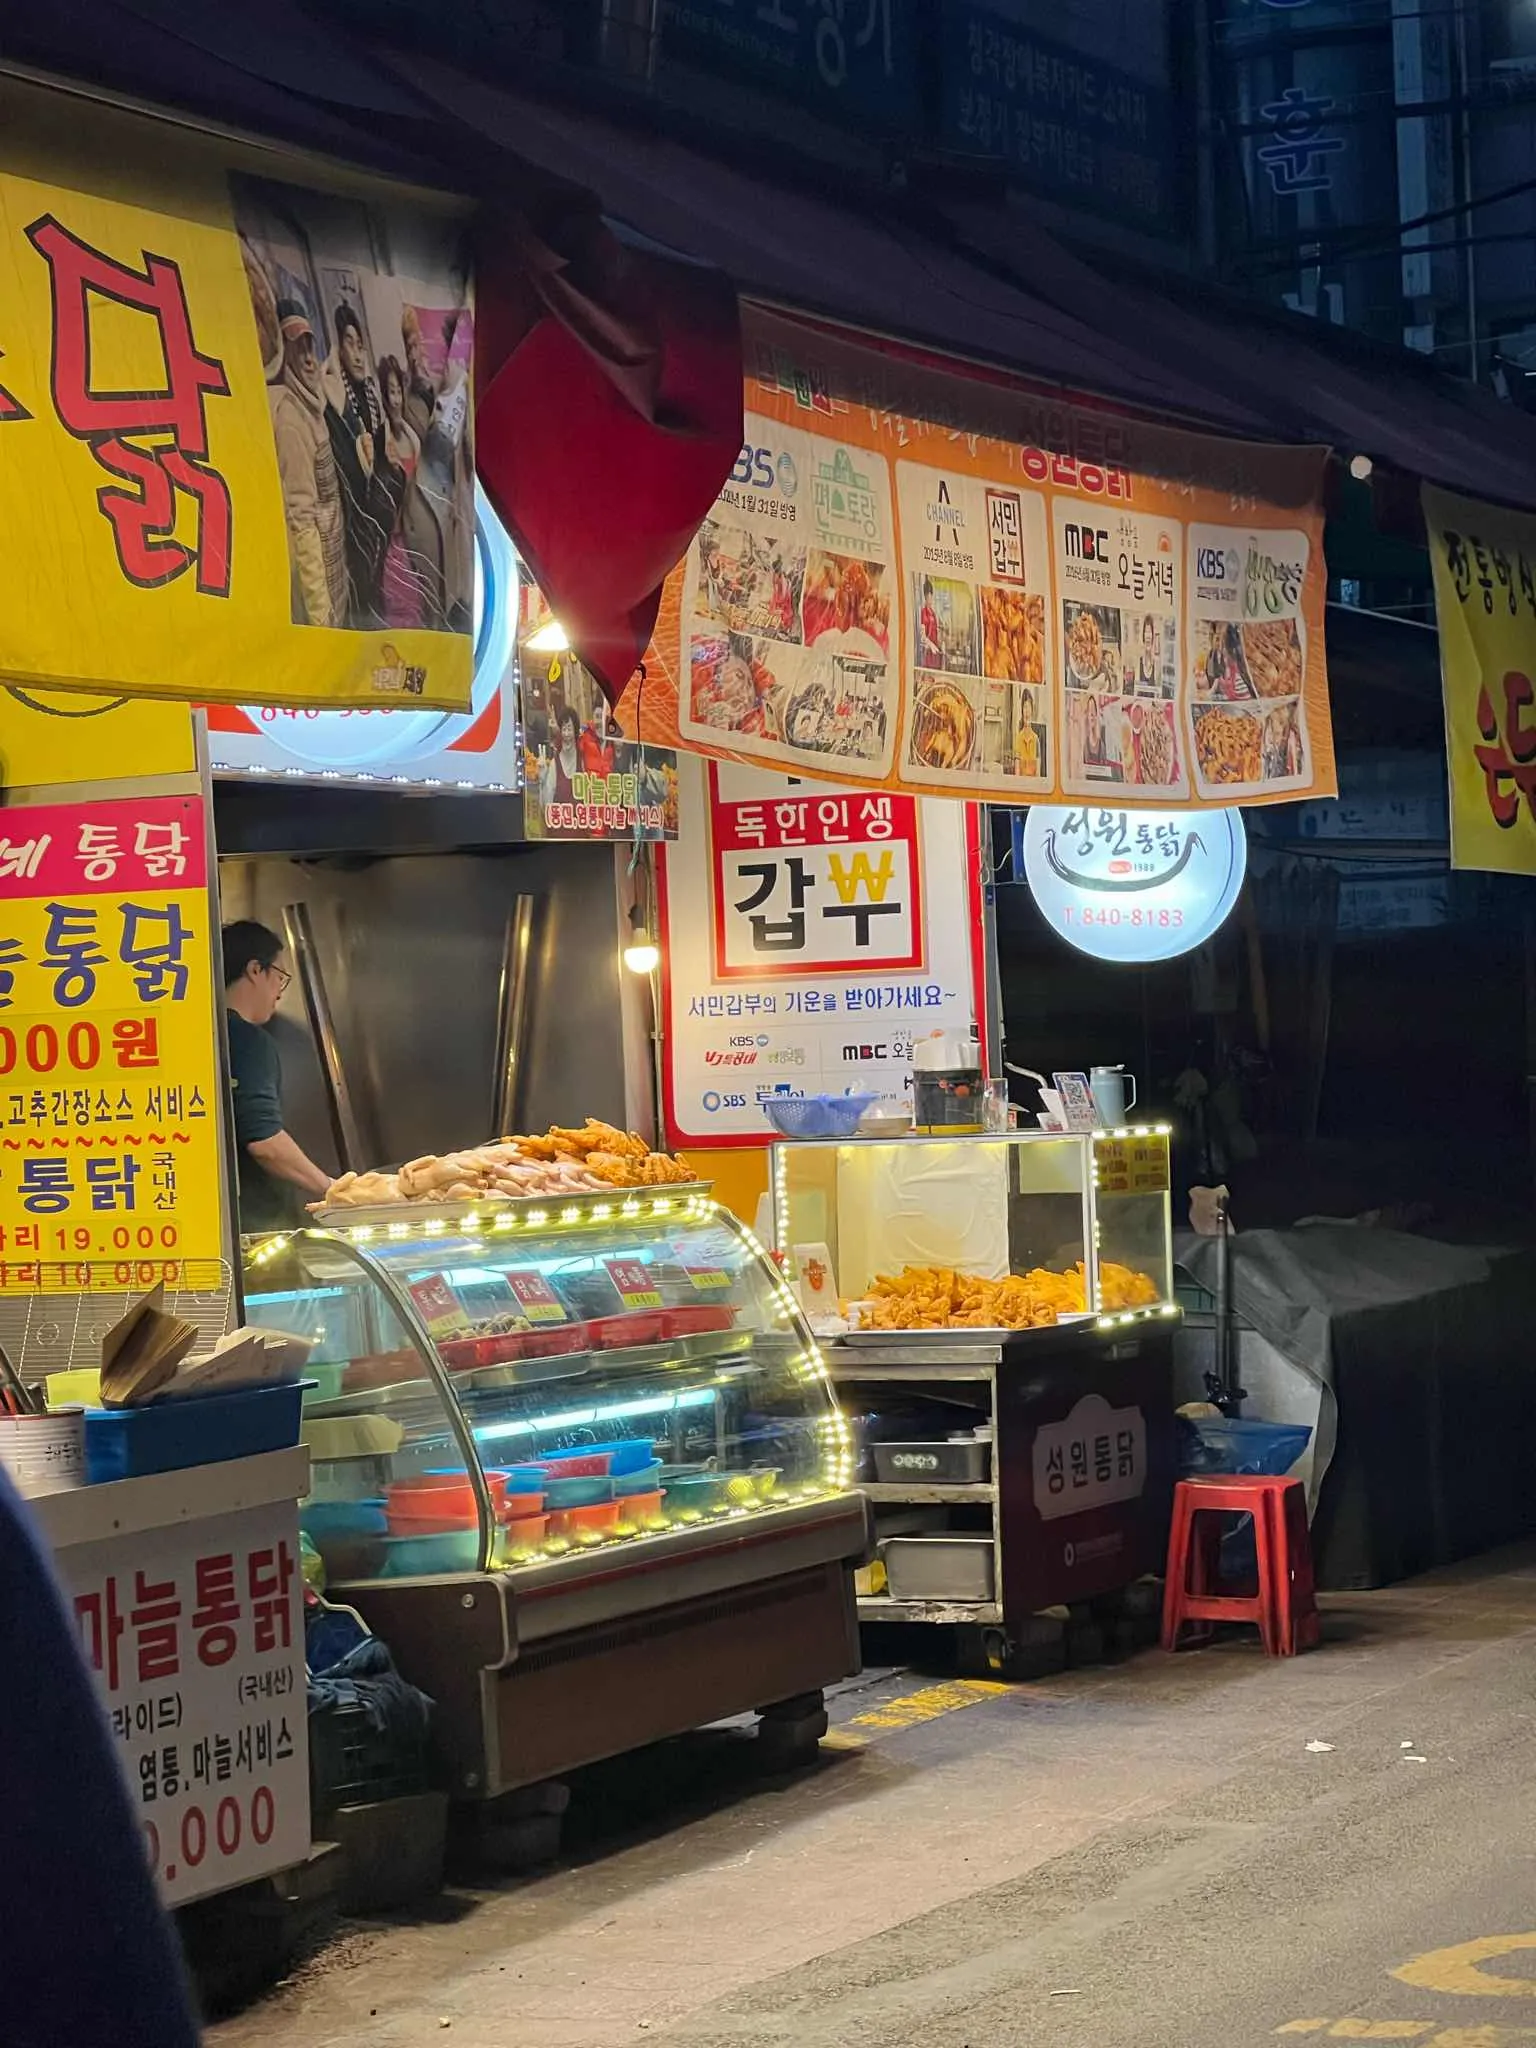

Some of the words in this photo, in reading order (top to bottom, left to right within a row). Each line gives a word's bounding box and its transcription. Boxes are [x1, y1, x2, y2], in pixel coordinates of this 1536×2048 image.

[24, 213, 231, 598] 닭
[926, 503, 966, 529] CHANNEL
[991, 499, 1017, 538] 서민
[992, 538, 1020, 575] 갑부
[1064, 523, 1109, 563] MBC
[1197, 548, 1224, 580] KBS
[74, 821, 191, 881] 통닭
[689, 993, 777, 1018] 서민갑부의
[785, 991, 837, 1013] 기운을
[729, 1036, 754, 1047] KBS
[843, 1044, 888, 1061] MBC
[145, 1085, 206, 1123] 서비스
[723, 1094, 746, 1108] SBS
[17, 1154, 142, 1213] 통닭
[152, 1152, 178, 1210] 국내산
[56, 1225, 178, 1252] 19.000
[74, 1539, 295, 1692] 마늘통닭
[238, 1665, 294, 1705] (국내산)
